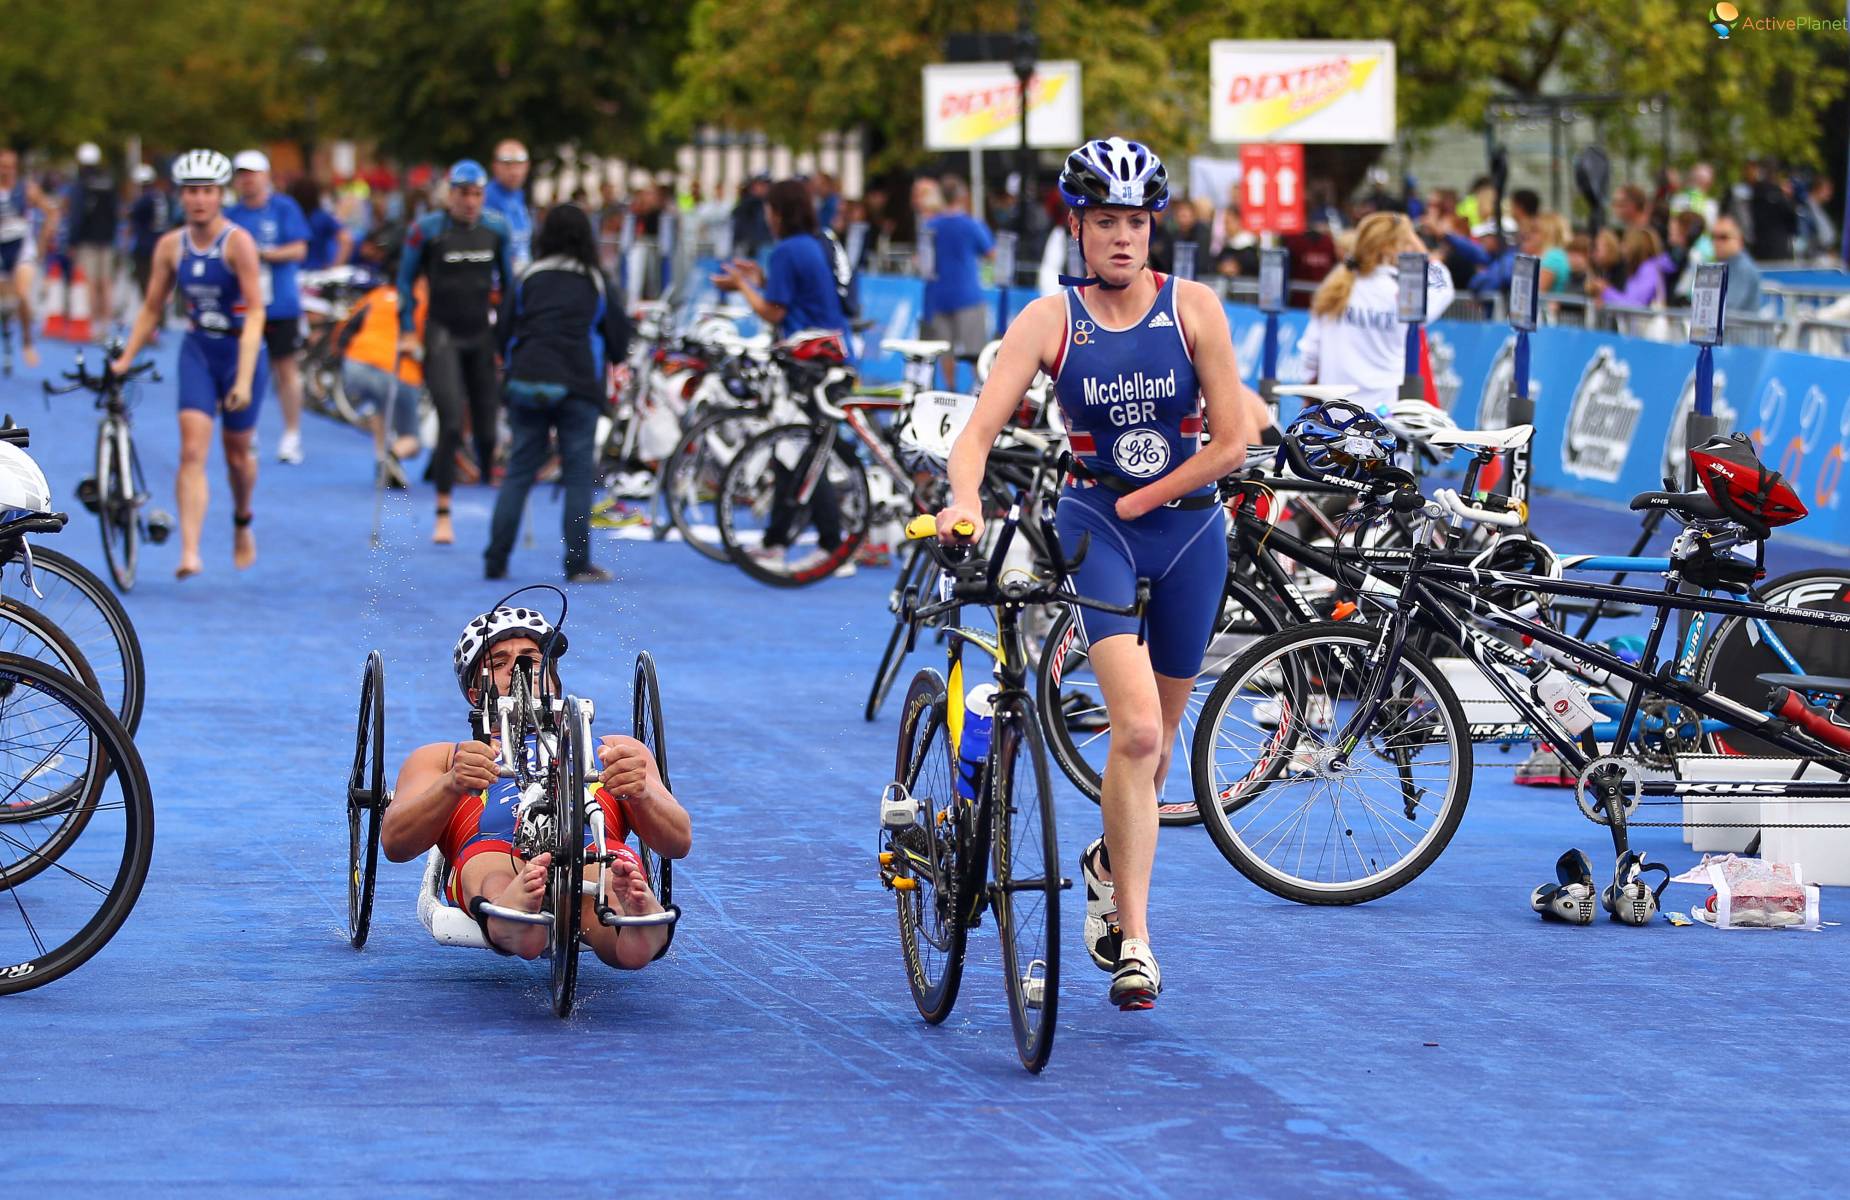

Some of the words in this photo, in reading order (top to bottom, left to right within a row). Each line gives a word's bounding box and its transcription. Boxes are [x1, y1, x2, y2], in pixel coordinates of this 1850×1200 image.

[1083, 368, 1176, 406] Mcclelland
[1109, 402, 1157, 427] GBR
[940, 413, 951, 438] 6
[1322, 474, 1373, 492] PROFILE
[1650, 497, 1669, 505] KHS
[1389, 550, 1413, 559] BAN
[1675, 783, 1788, 794] KHS
